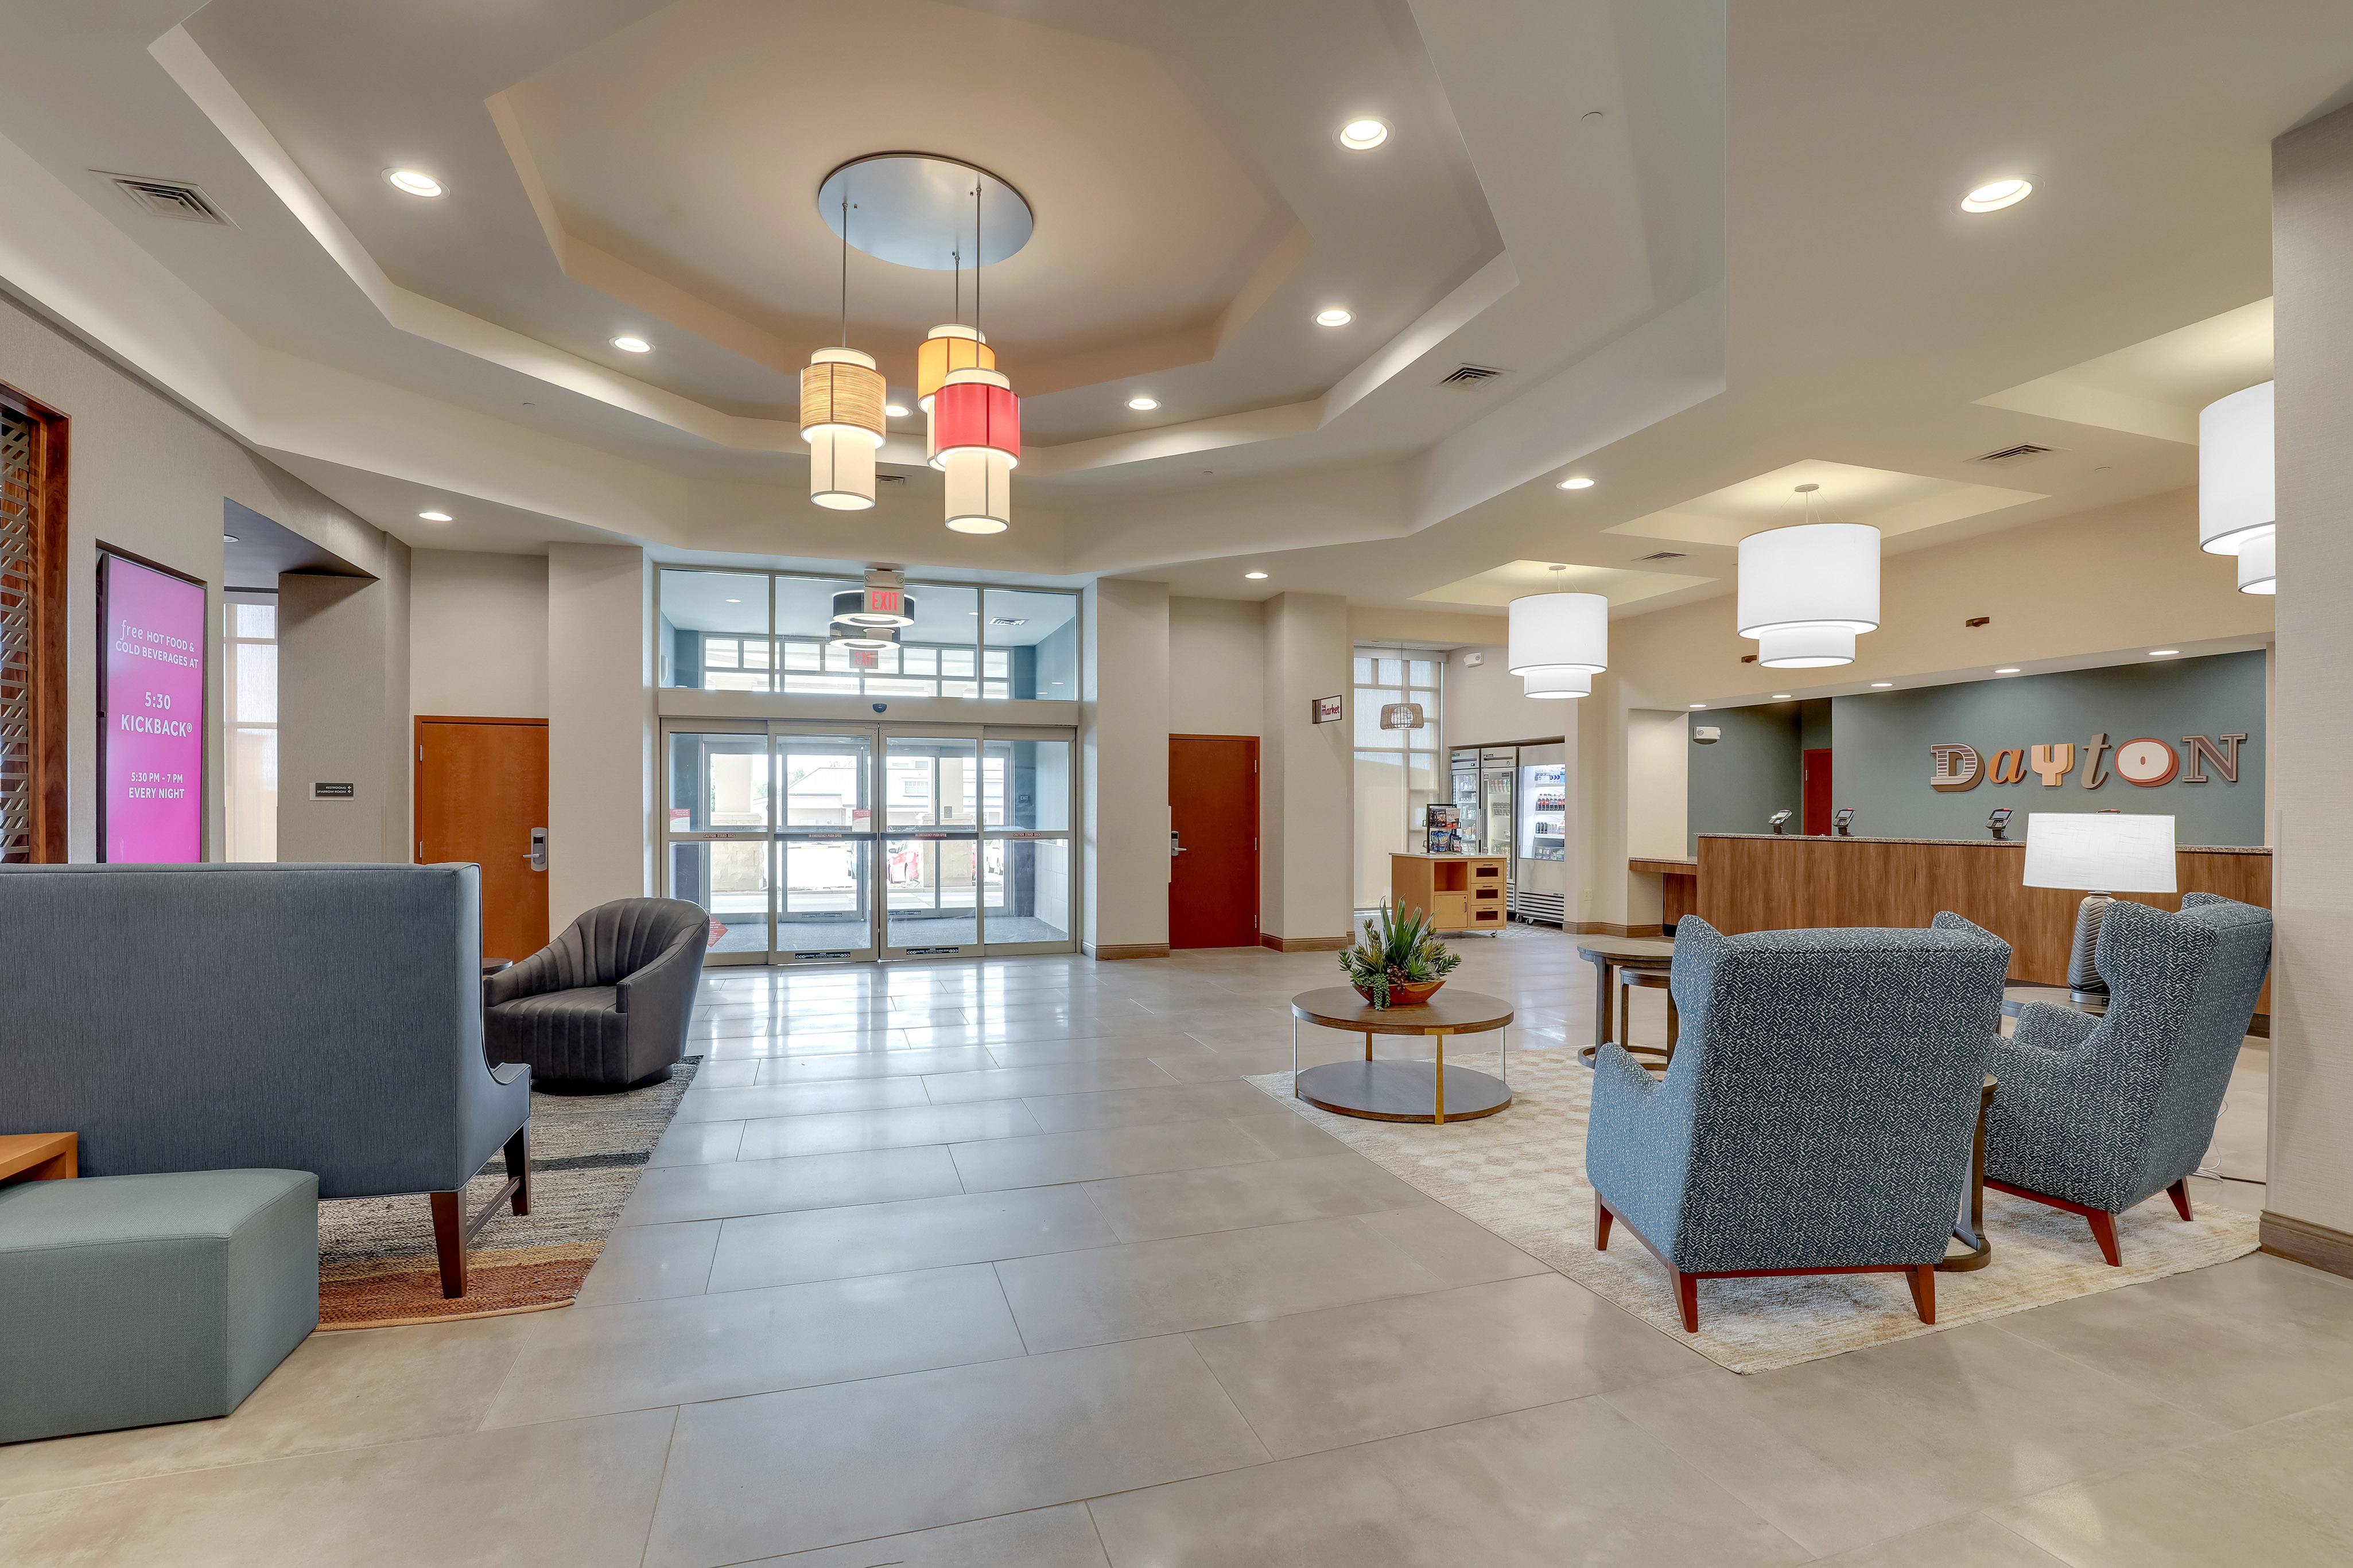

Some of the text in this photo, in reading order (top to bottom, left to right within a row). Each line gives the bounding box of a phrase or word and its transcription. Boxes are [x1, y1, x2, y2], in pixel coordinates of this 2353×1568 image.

[872, 591, 899, 610] EXIT
[120, 620, 195, 652] free HOT FOOD &
[115, 640, 199, 668] COLD BEVERAGES AT
[855, 652, 874, 666] EXIT
[145, 691, 171, 710] 5:30
[1322, 704, 1339, 716] market
[131, 772, 147, 782] 5:30
[149, 772, 160, 783] PM
[167, 774, 171, 783] 7
[173, 774, 183, 783] PM
[129, 787, 185, 799] EVERY NIGHT
